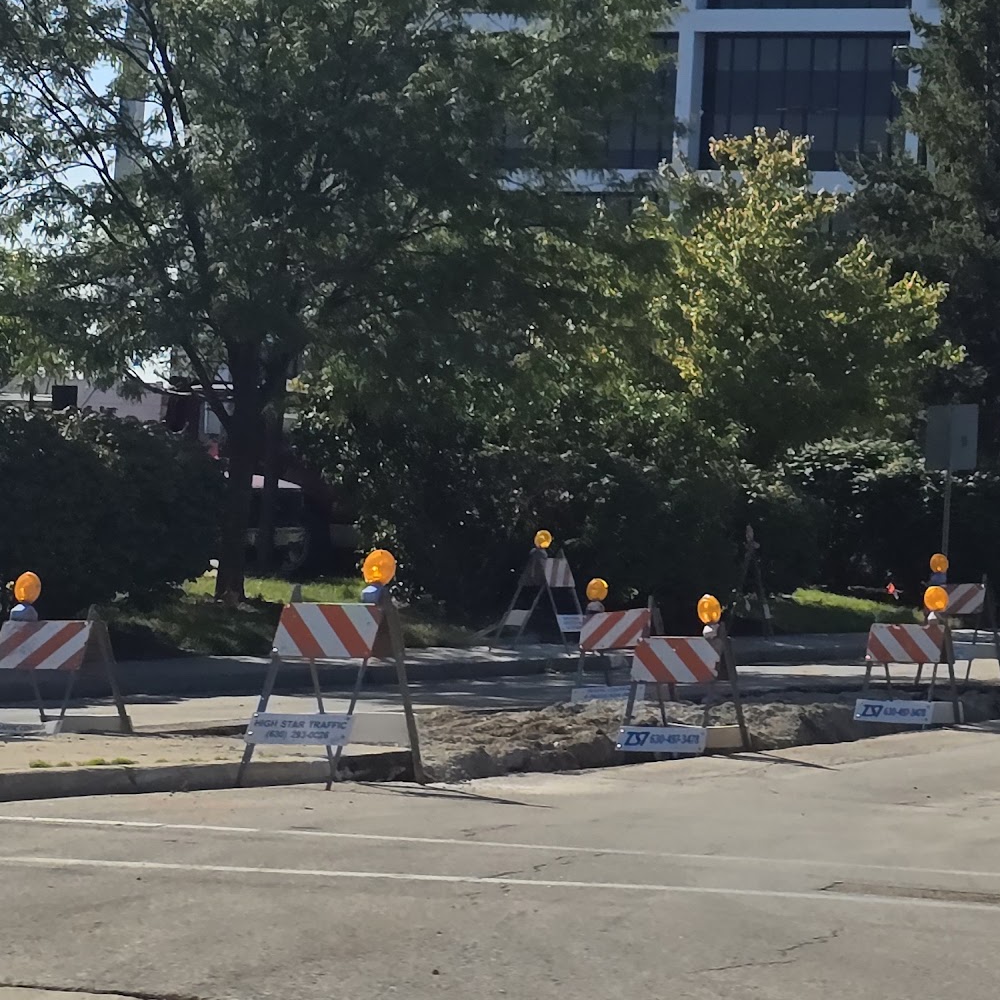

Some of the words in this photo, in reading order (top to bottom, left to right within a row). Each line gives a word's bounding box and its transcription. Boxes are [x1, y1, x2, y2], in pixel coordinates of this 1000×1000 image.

[254, 719, 278, 727] HIGH
[280, 720, 305, 728] STAR
[309, 721, 348, 730] TRAFFIC
